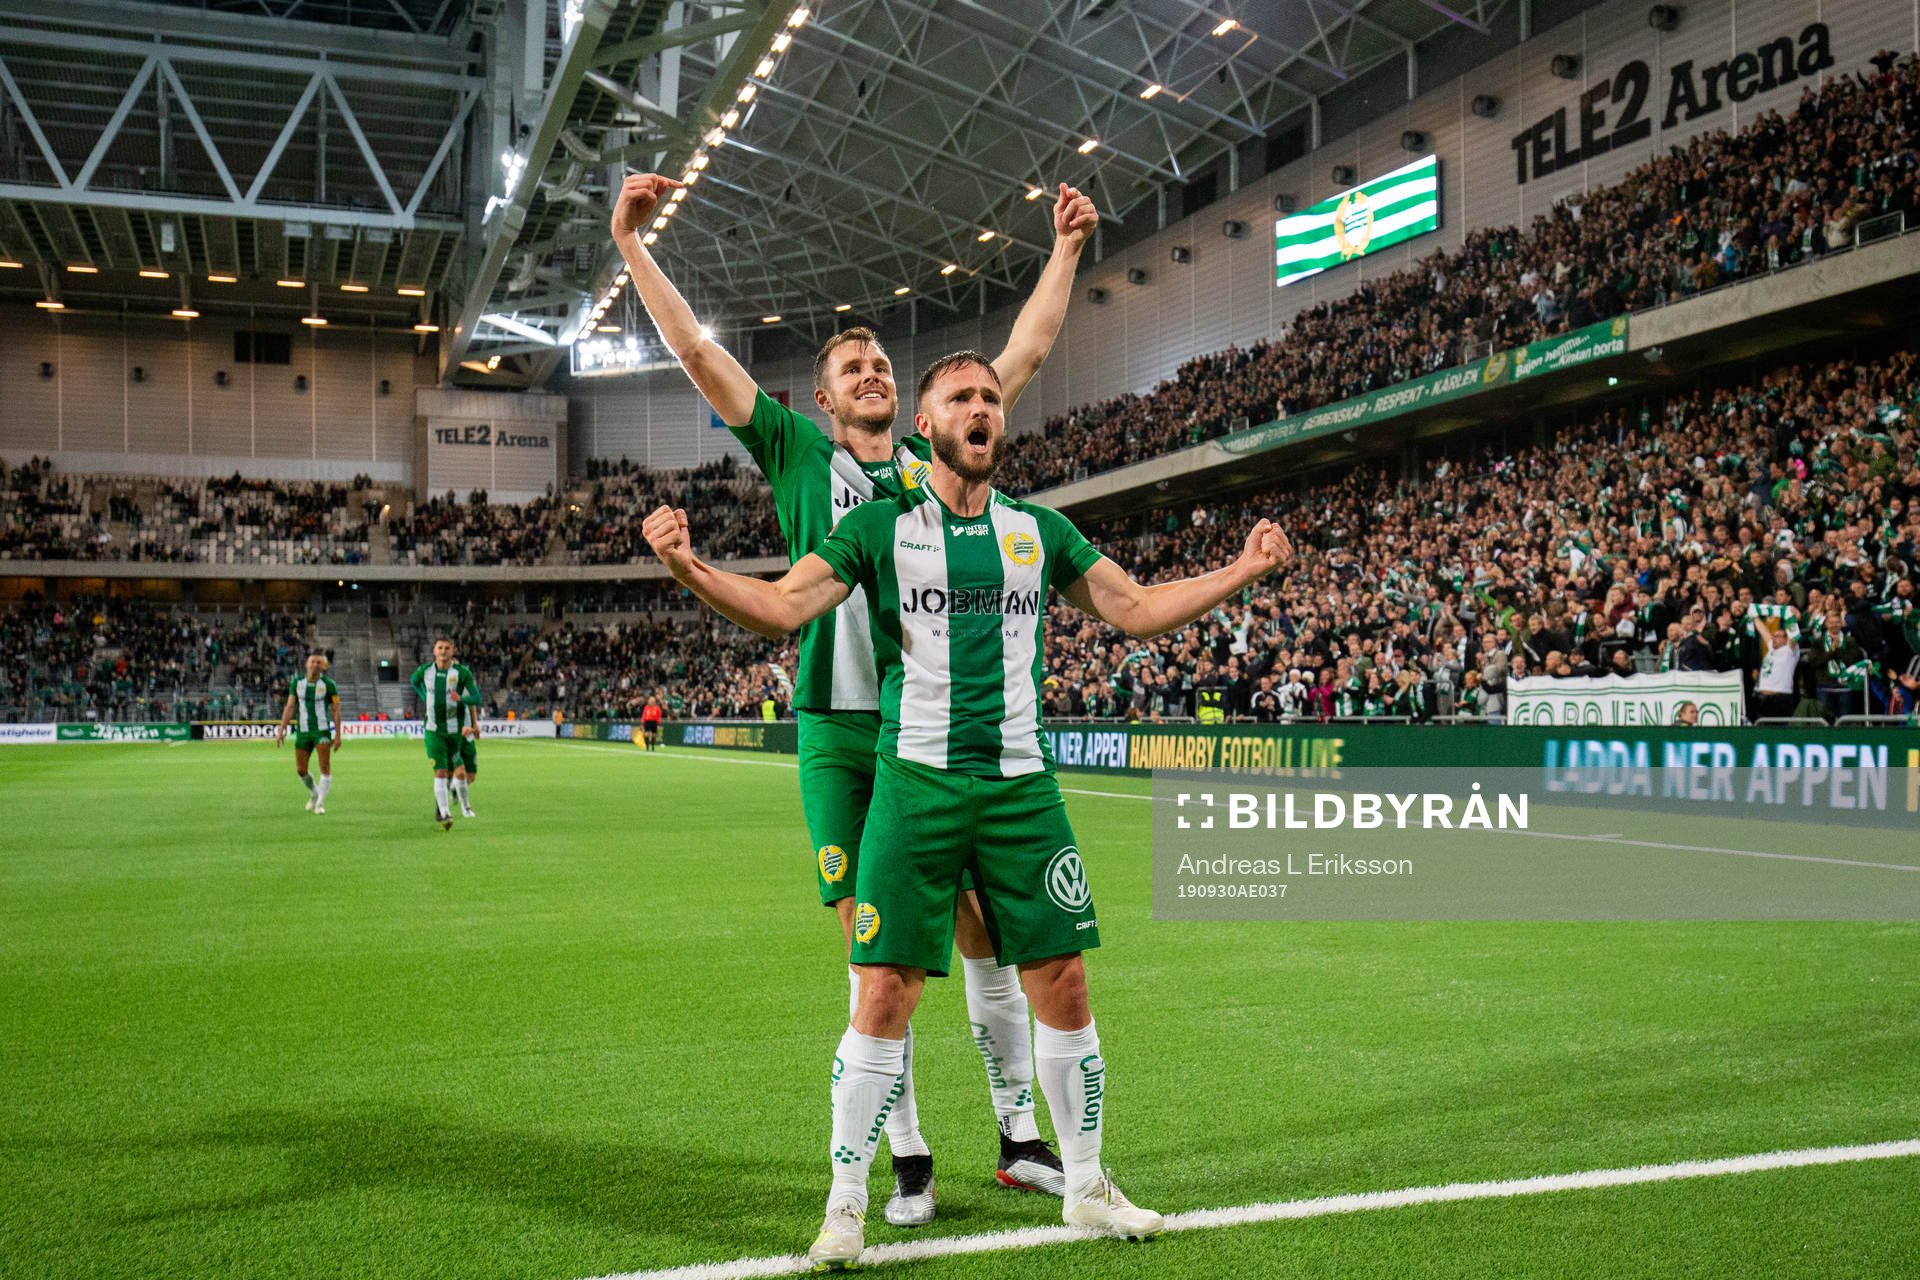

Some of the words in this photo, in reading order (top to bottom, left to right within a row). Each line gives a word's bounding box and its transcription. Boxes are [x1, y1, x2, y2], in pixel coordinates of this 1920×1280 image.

[1511, 59, 1651, 185] TELE2
[1661, 22, 1835, 130] Arena
[435, 424, 491, 445] TELE2
[495, 431, 550, 448] Arena
[899, 540, 932, 552] CRAFT
[902, 587, 1039, 616] JOBMAN
[1059, 732, 1083, 765] NER
[1084, 732, 1128, 768] APPEN
[1129, 734, 1218, 772] HAMMARBY
[1220, 736, 1295, 776] FOTBOLL
[1544, 740, 1652, 796] LADDA
[1661, 741, 1737, 801] NER
[1746, 743, 1888, 811] APPEN
[1080, 1054, 1105, 1132] Clinton
